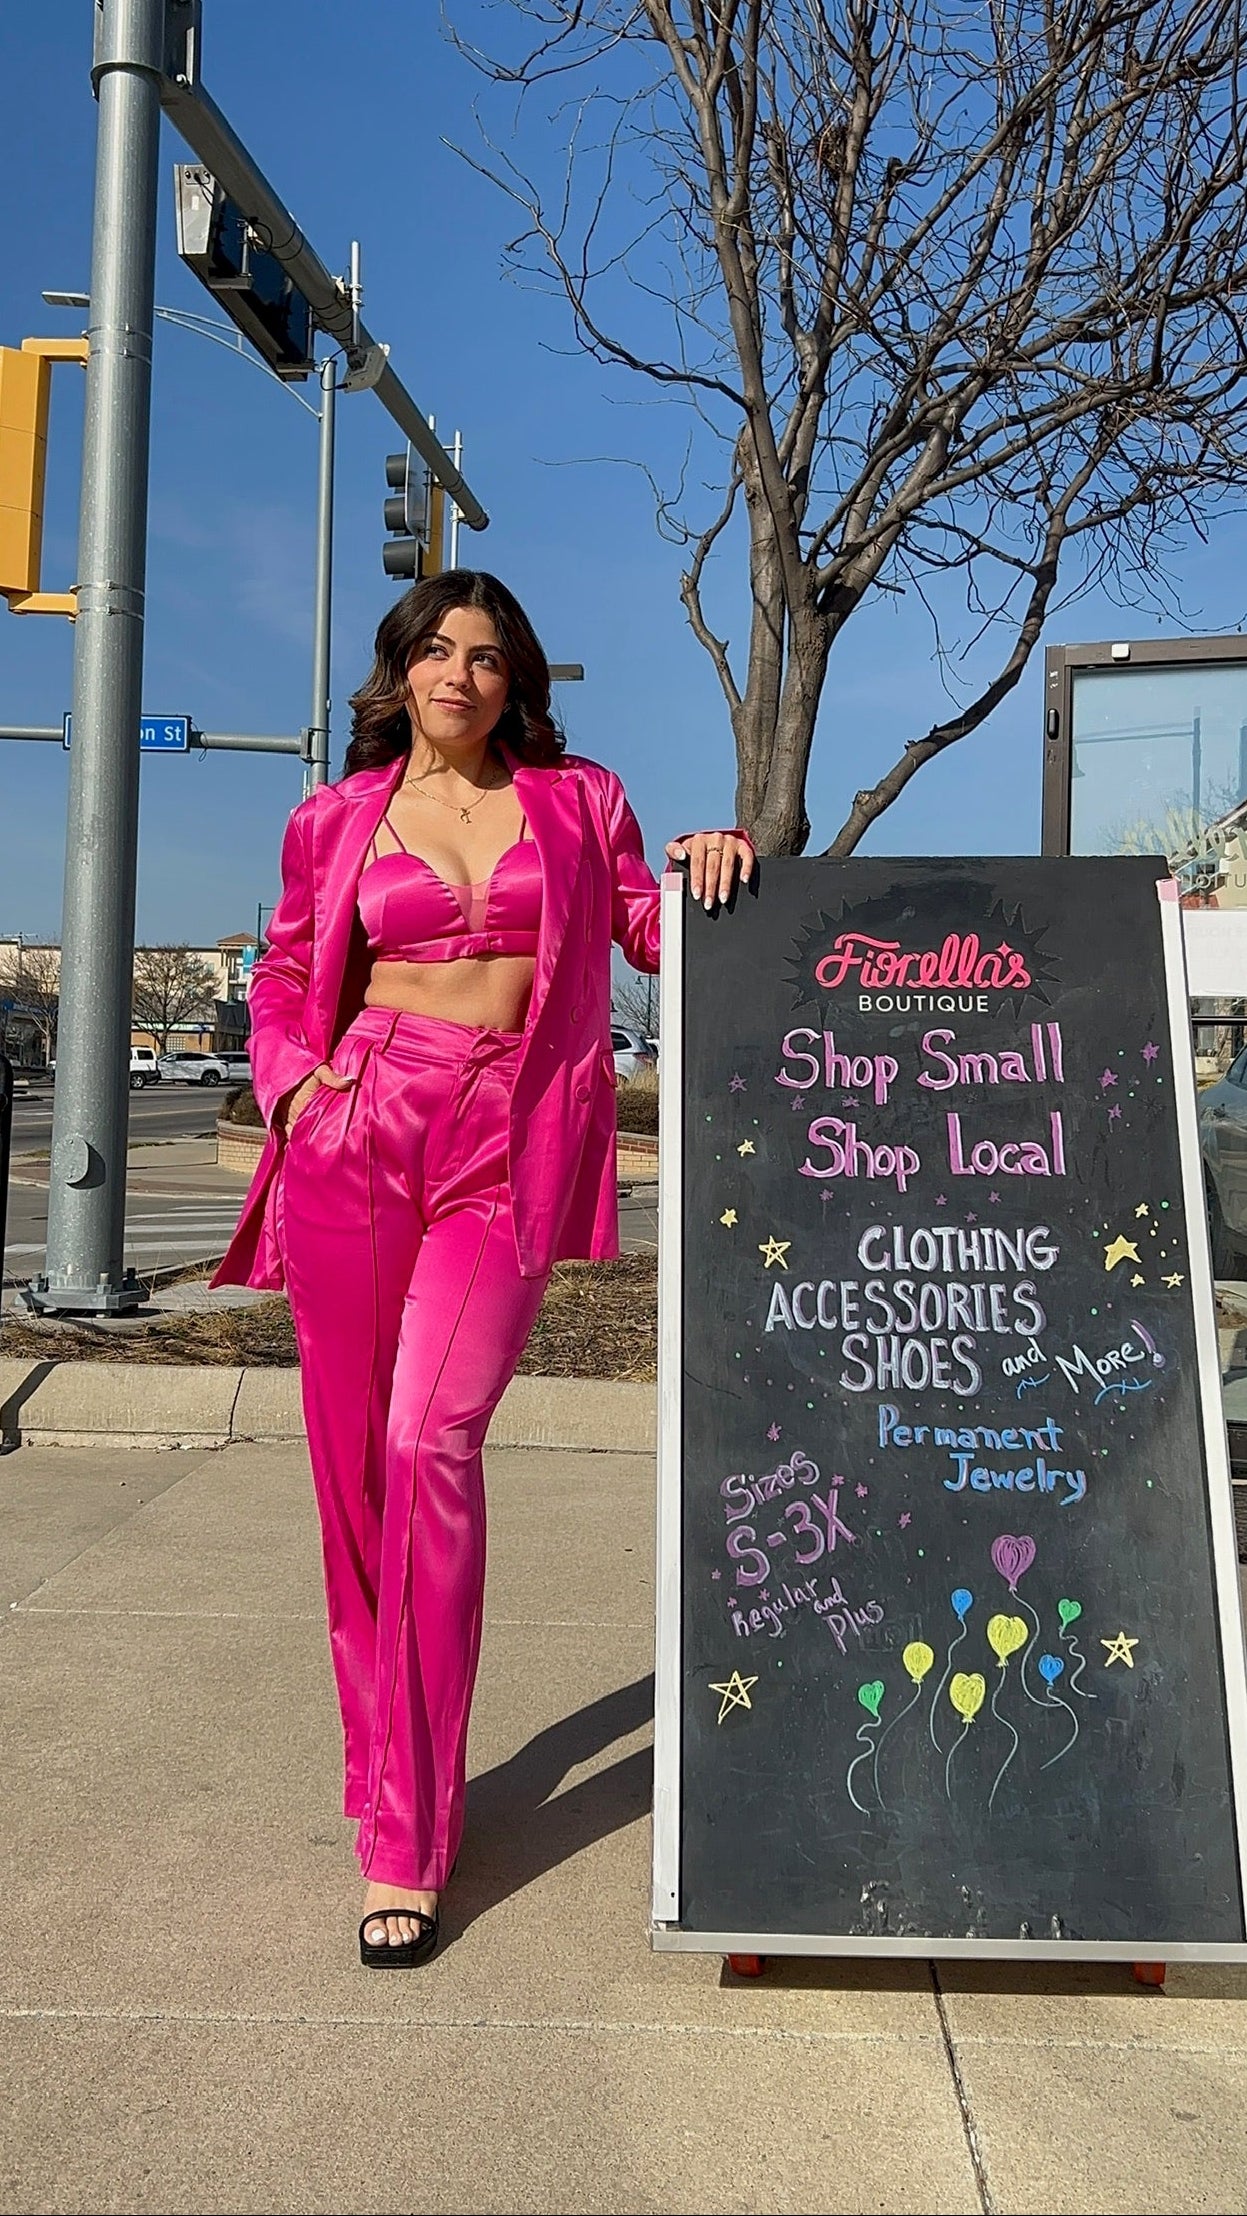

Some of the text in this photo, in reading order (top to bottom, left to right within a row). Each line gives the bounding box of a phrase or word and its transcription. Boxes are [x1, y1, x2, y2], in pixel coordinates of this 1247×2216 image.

[164, 726, 181, 741] St
[815, 932, 1032, 990] Fiorella's
[858, 994, 989, 1013] BOUTIQUE
[774, 1022, 1064, 1105] Shop Small
[798, 1111, 1066, 1193] Shop Local
[858, 1225, 1059, 1272] CLOTHING
[764, 1280, 1046, 1336] ACCESSORIES
[839, 1333, 982, 1396] SHOES
[1002, 1338, 1047, 1378] and
[878, 1404, 1064, 1452] Permanent
[720, 1451, 820, 1524] Sizes
[943, 1453, 1086, 1506] Jewelry
[726, 1489, 857, 1586] S-3X
[731, 1577, 848, 1638] Regular and
